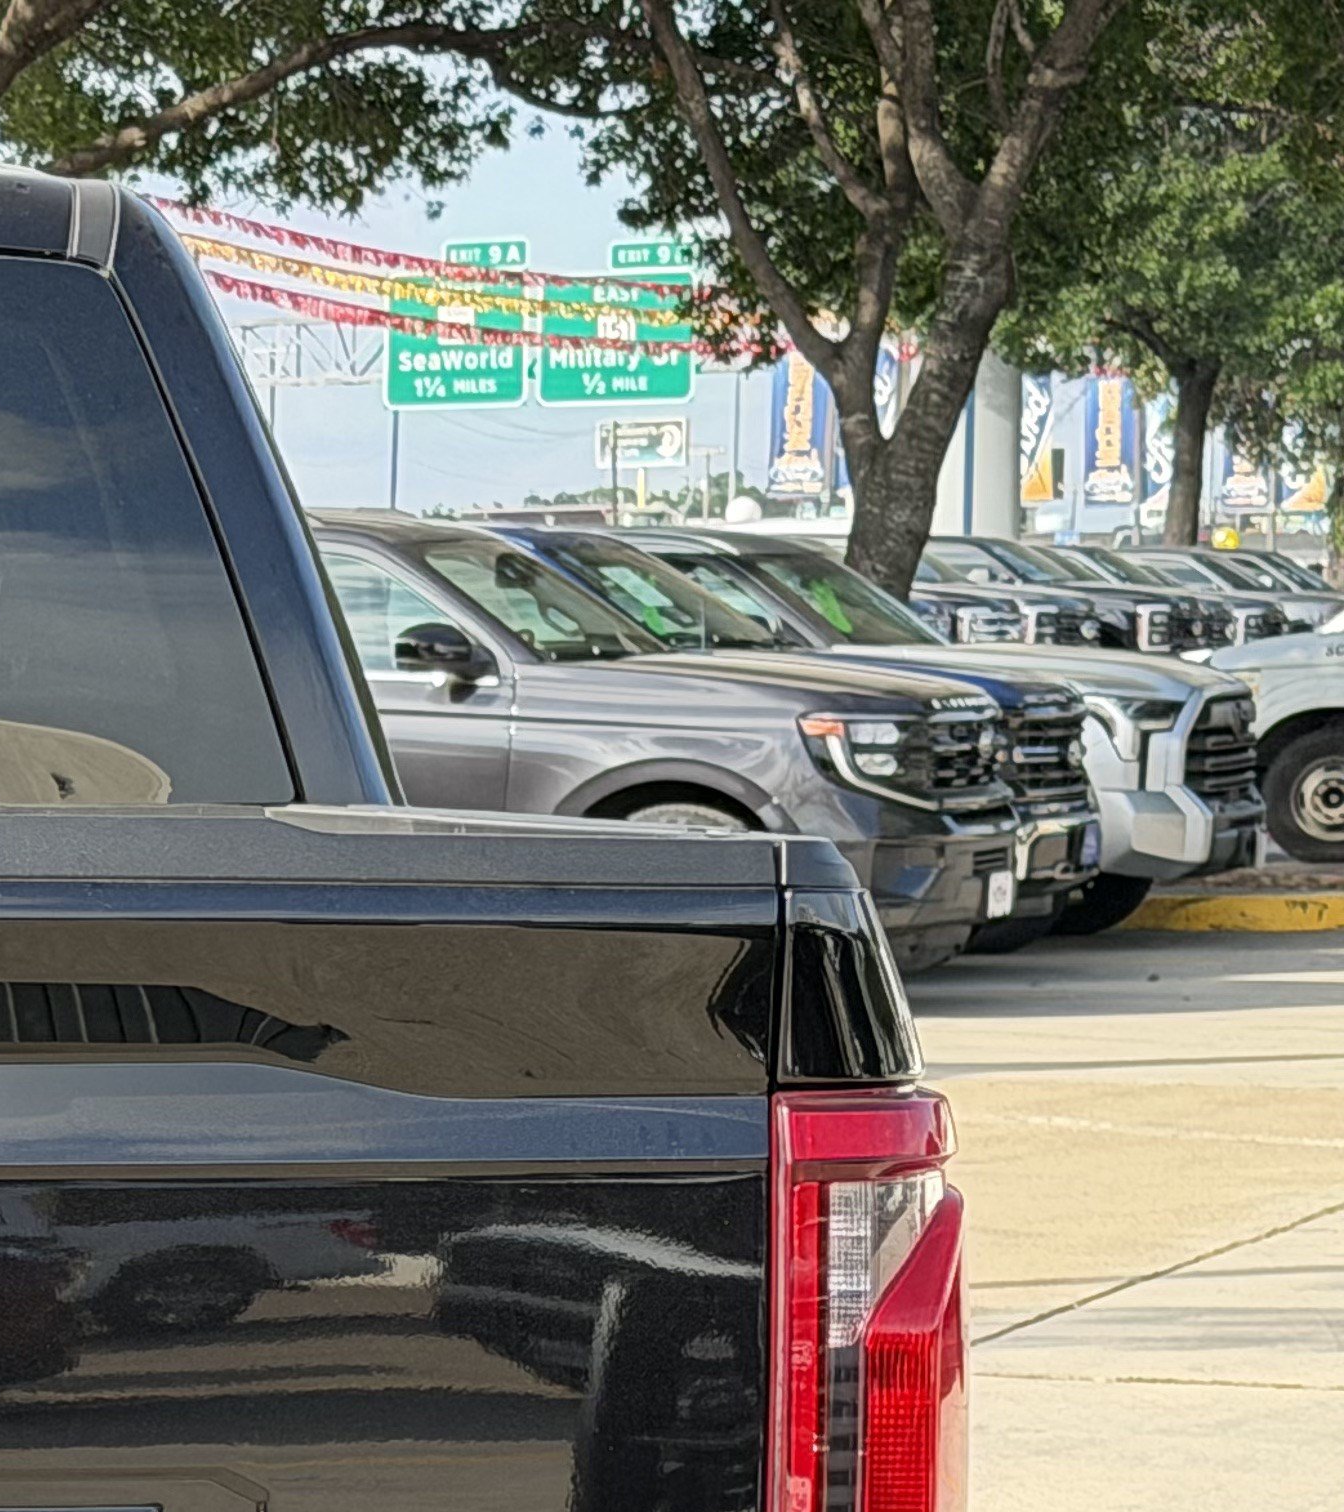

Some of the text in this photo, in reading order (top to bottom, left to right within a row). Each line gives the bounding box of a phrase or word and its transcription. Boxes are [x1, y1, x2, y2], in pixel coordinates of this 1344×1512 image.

[449, 247, 482, 263] EXIT
[617, 248, 650, 264] EXIT
[398, 346, 514, 372] SeaWorld
[549, 346, 641, 372] Military
[453, 378, 498, 394] MILES
[611, 375, 649, 393] MILE
